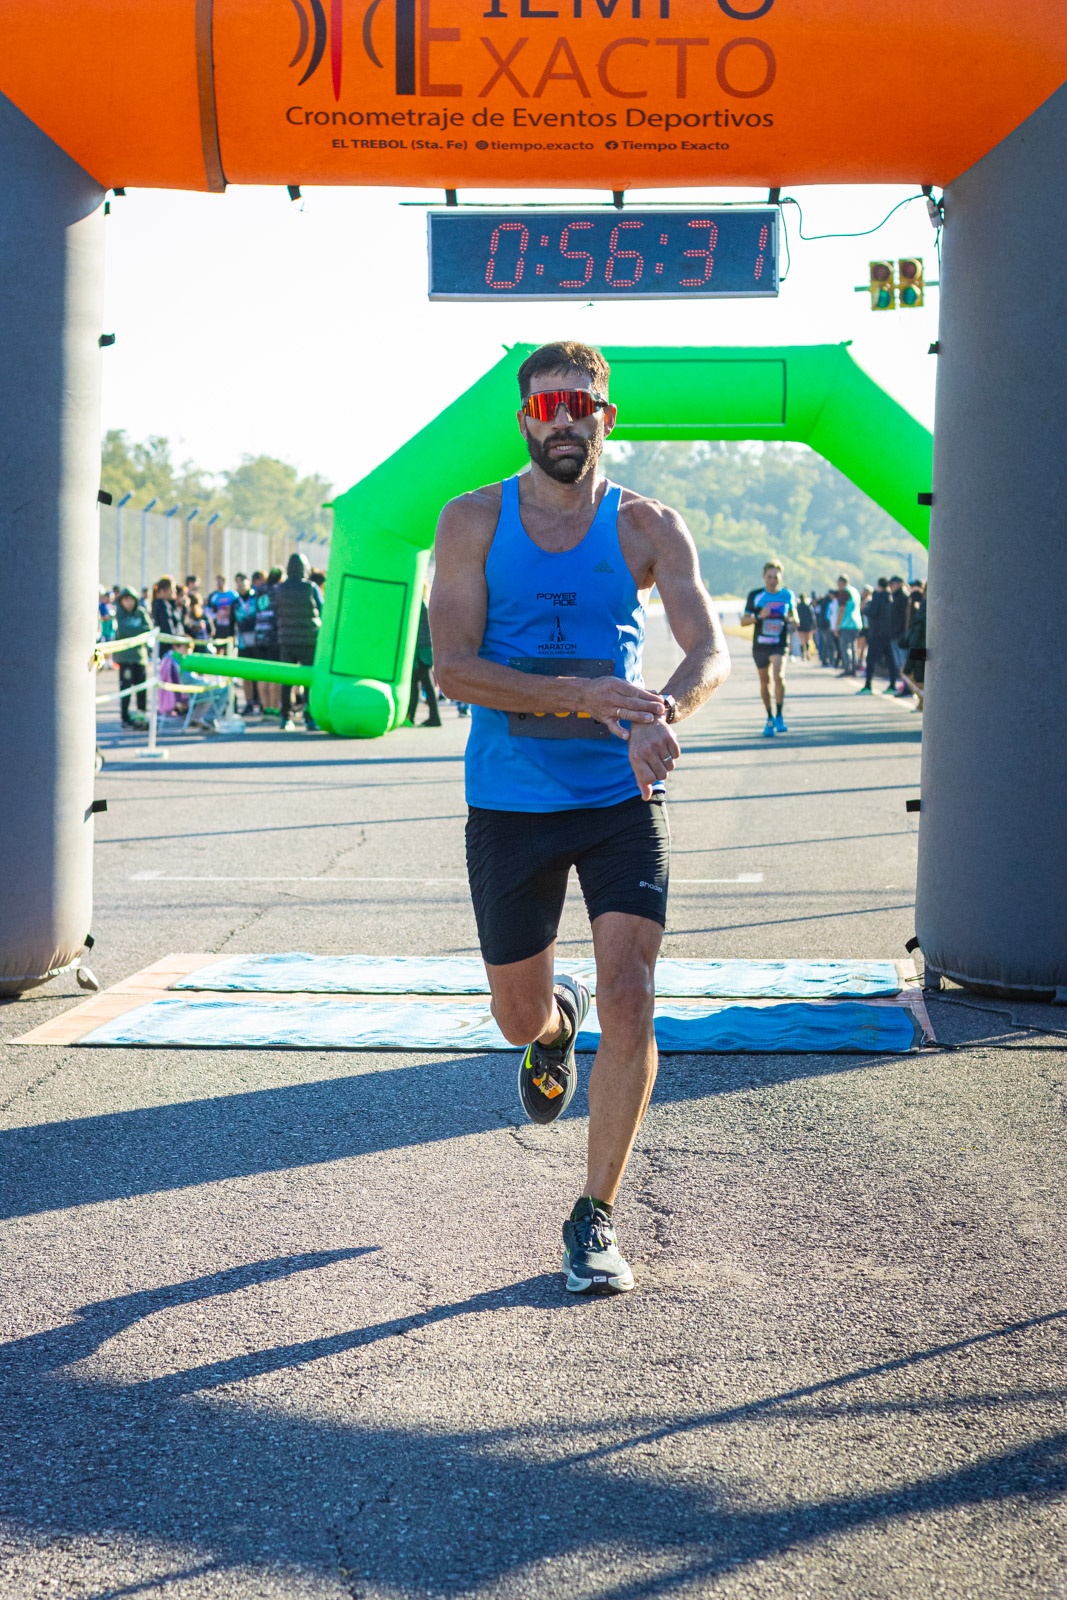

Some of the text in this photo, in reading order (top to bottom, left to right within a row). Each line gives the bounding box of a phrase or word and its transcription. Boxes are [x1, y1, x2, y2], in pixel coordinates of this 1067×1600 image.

[419, 0, 777, 99] EXACTO
[286, 106, 774, 132] Cronometraje de Eventos Deportivos
[331, 139, 730, 152] EL TREBOL (Sta. Fe) tiempo.exacto Tiempo Exacto
[485, 220, 768, 289] 0:56:31
[536, 592, 577, 600] POWER
